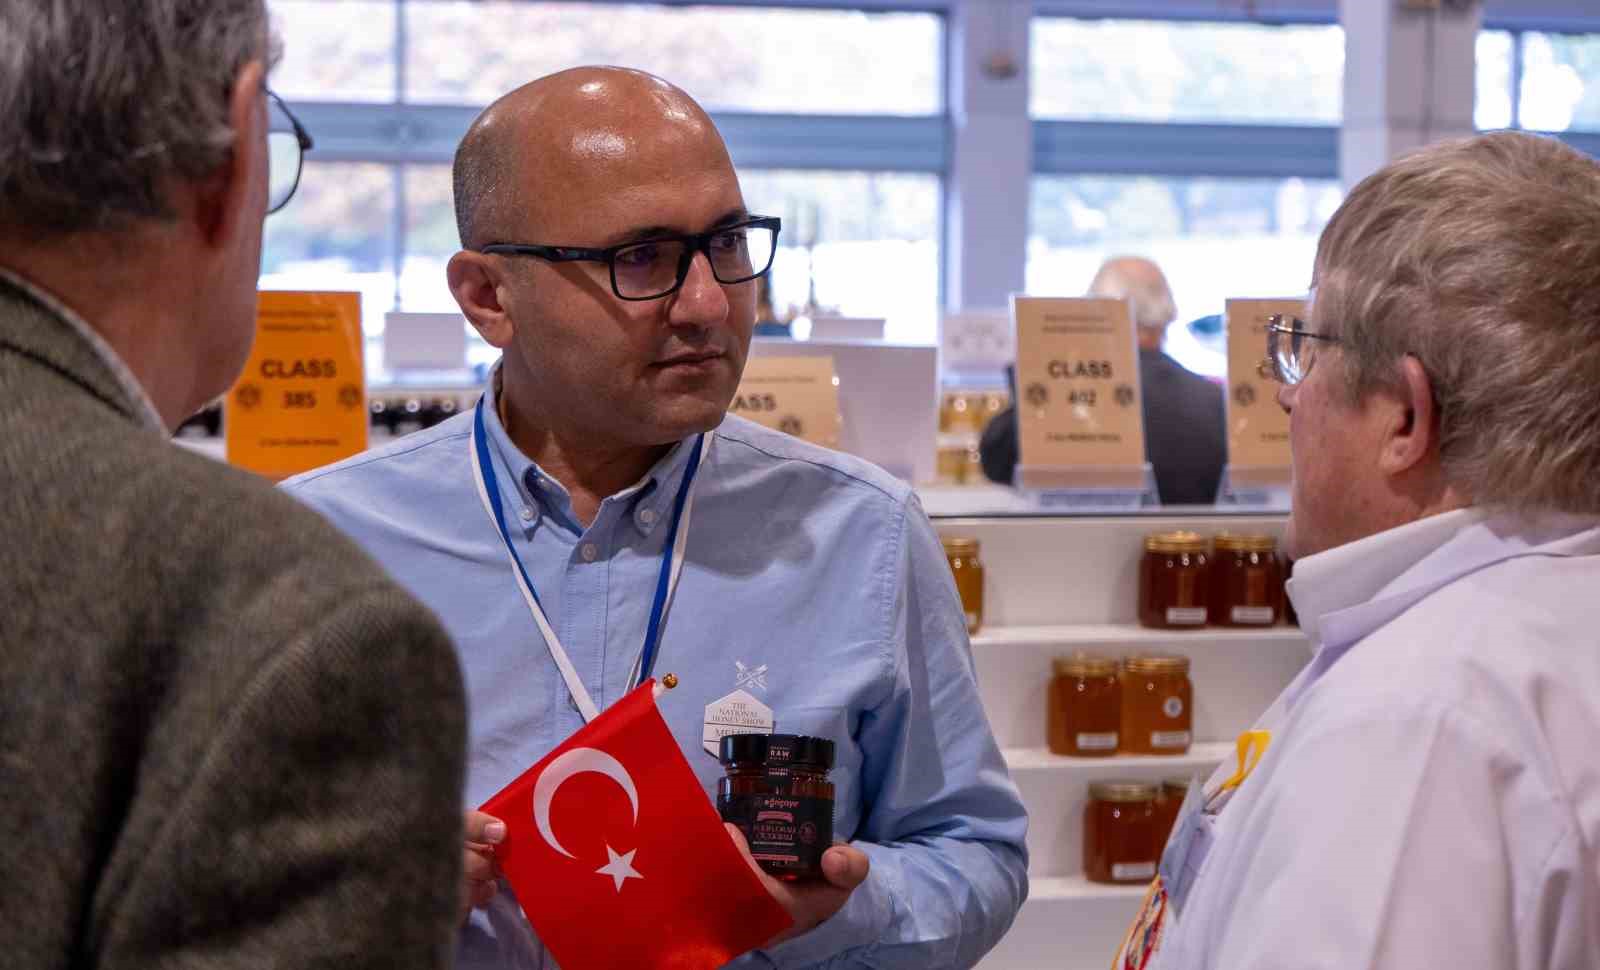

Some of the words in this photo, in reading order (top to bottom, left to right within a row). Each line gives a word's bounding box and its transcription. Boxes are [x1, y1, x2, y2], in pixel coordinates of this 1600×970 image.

[261, 360, 336, 378] CLASS
[1048, 360, 1113, 379] CLASS
[736, 394, 775, 411] ASS
[719, 707, 759, 719] NATIONAL
[712, 715, 742, 723] HONEY
[742, 718, 765, 726] SHOW
[770, 749, 790, 758] RAW
